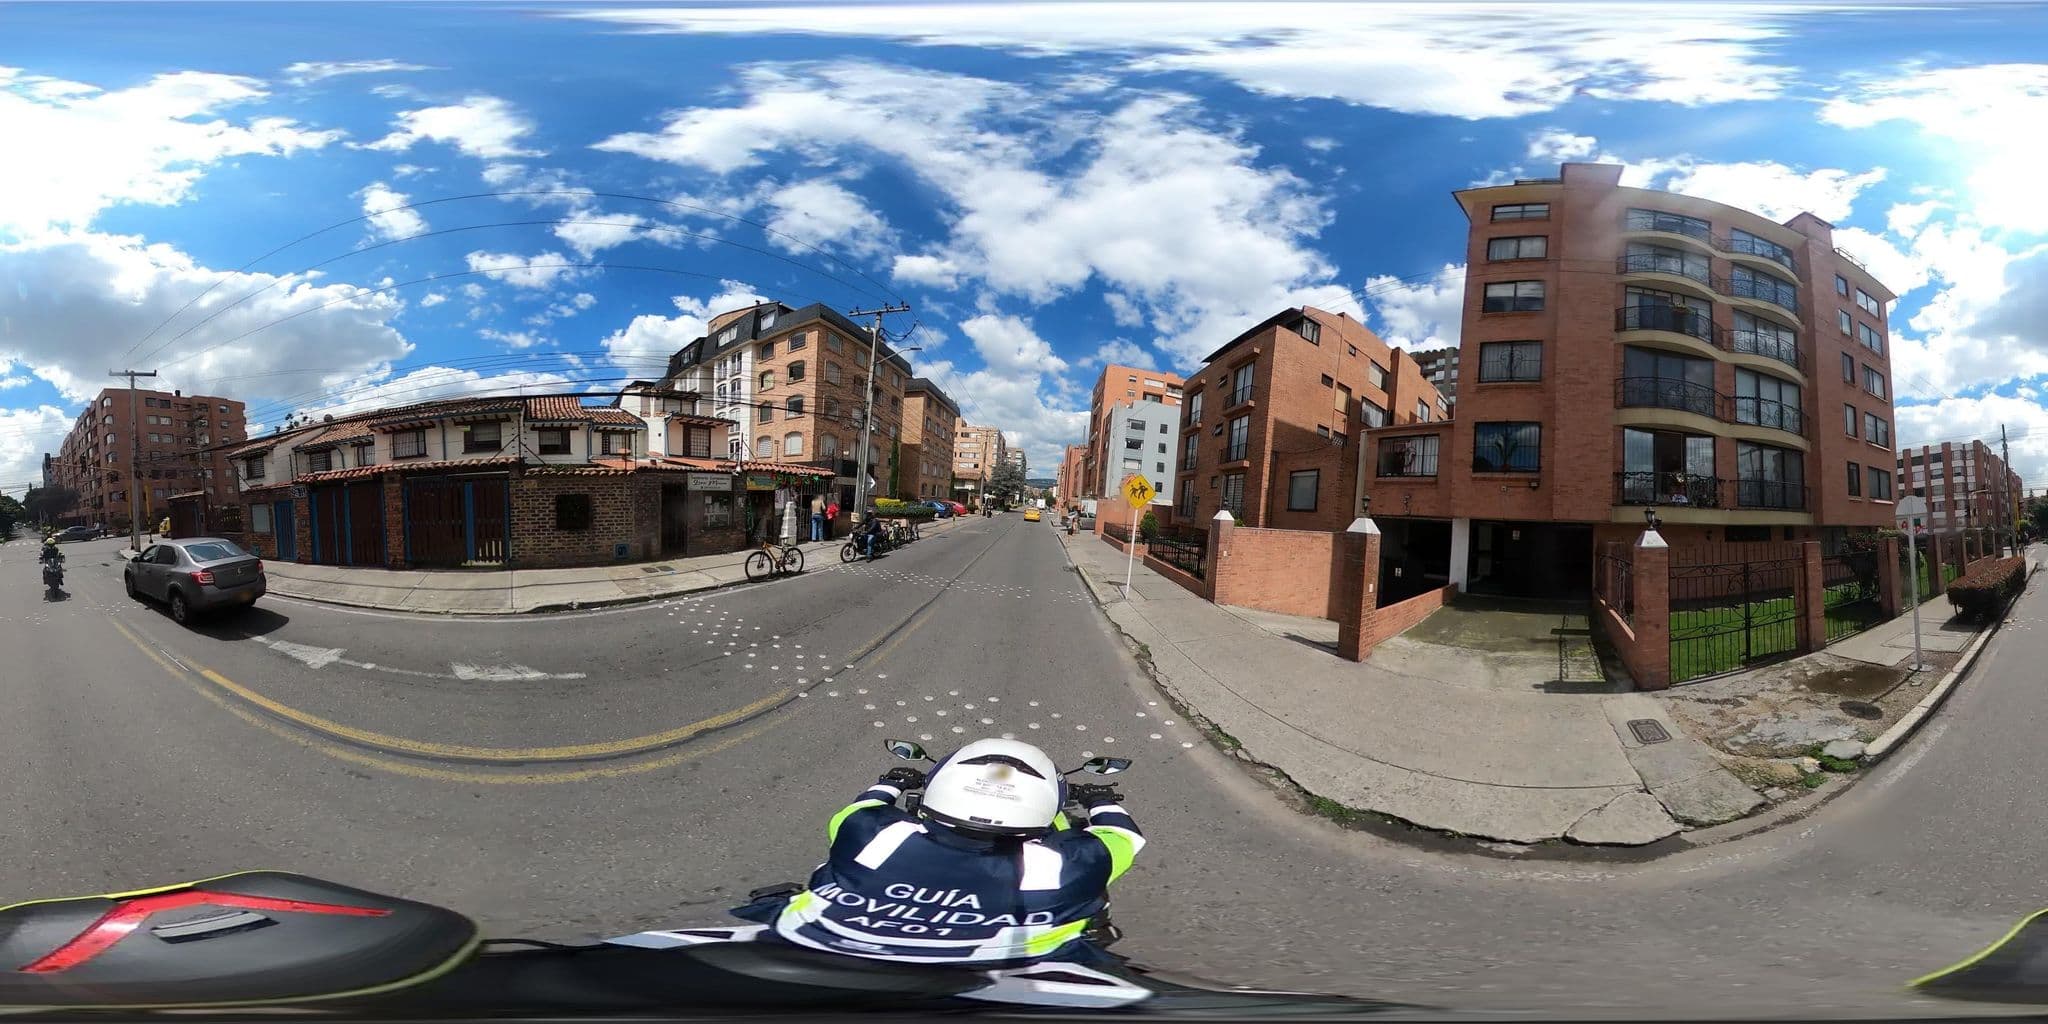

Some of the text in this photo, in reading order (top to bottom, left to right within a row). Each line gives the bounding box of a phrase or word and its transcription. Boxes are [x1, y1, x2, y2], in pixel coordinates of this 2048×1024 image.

[813, 882, 1055, 927] MOVILIDAD
[884, 882, 982, 910] GUÍA
[844, 915, 954, 937] AF01
